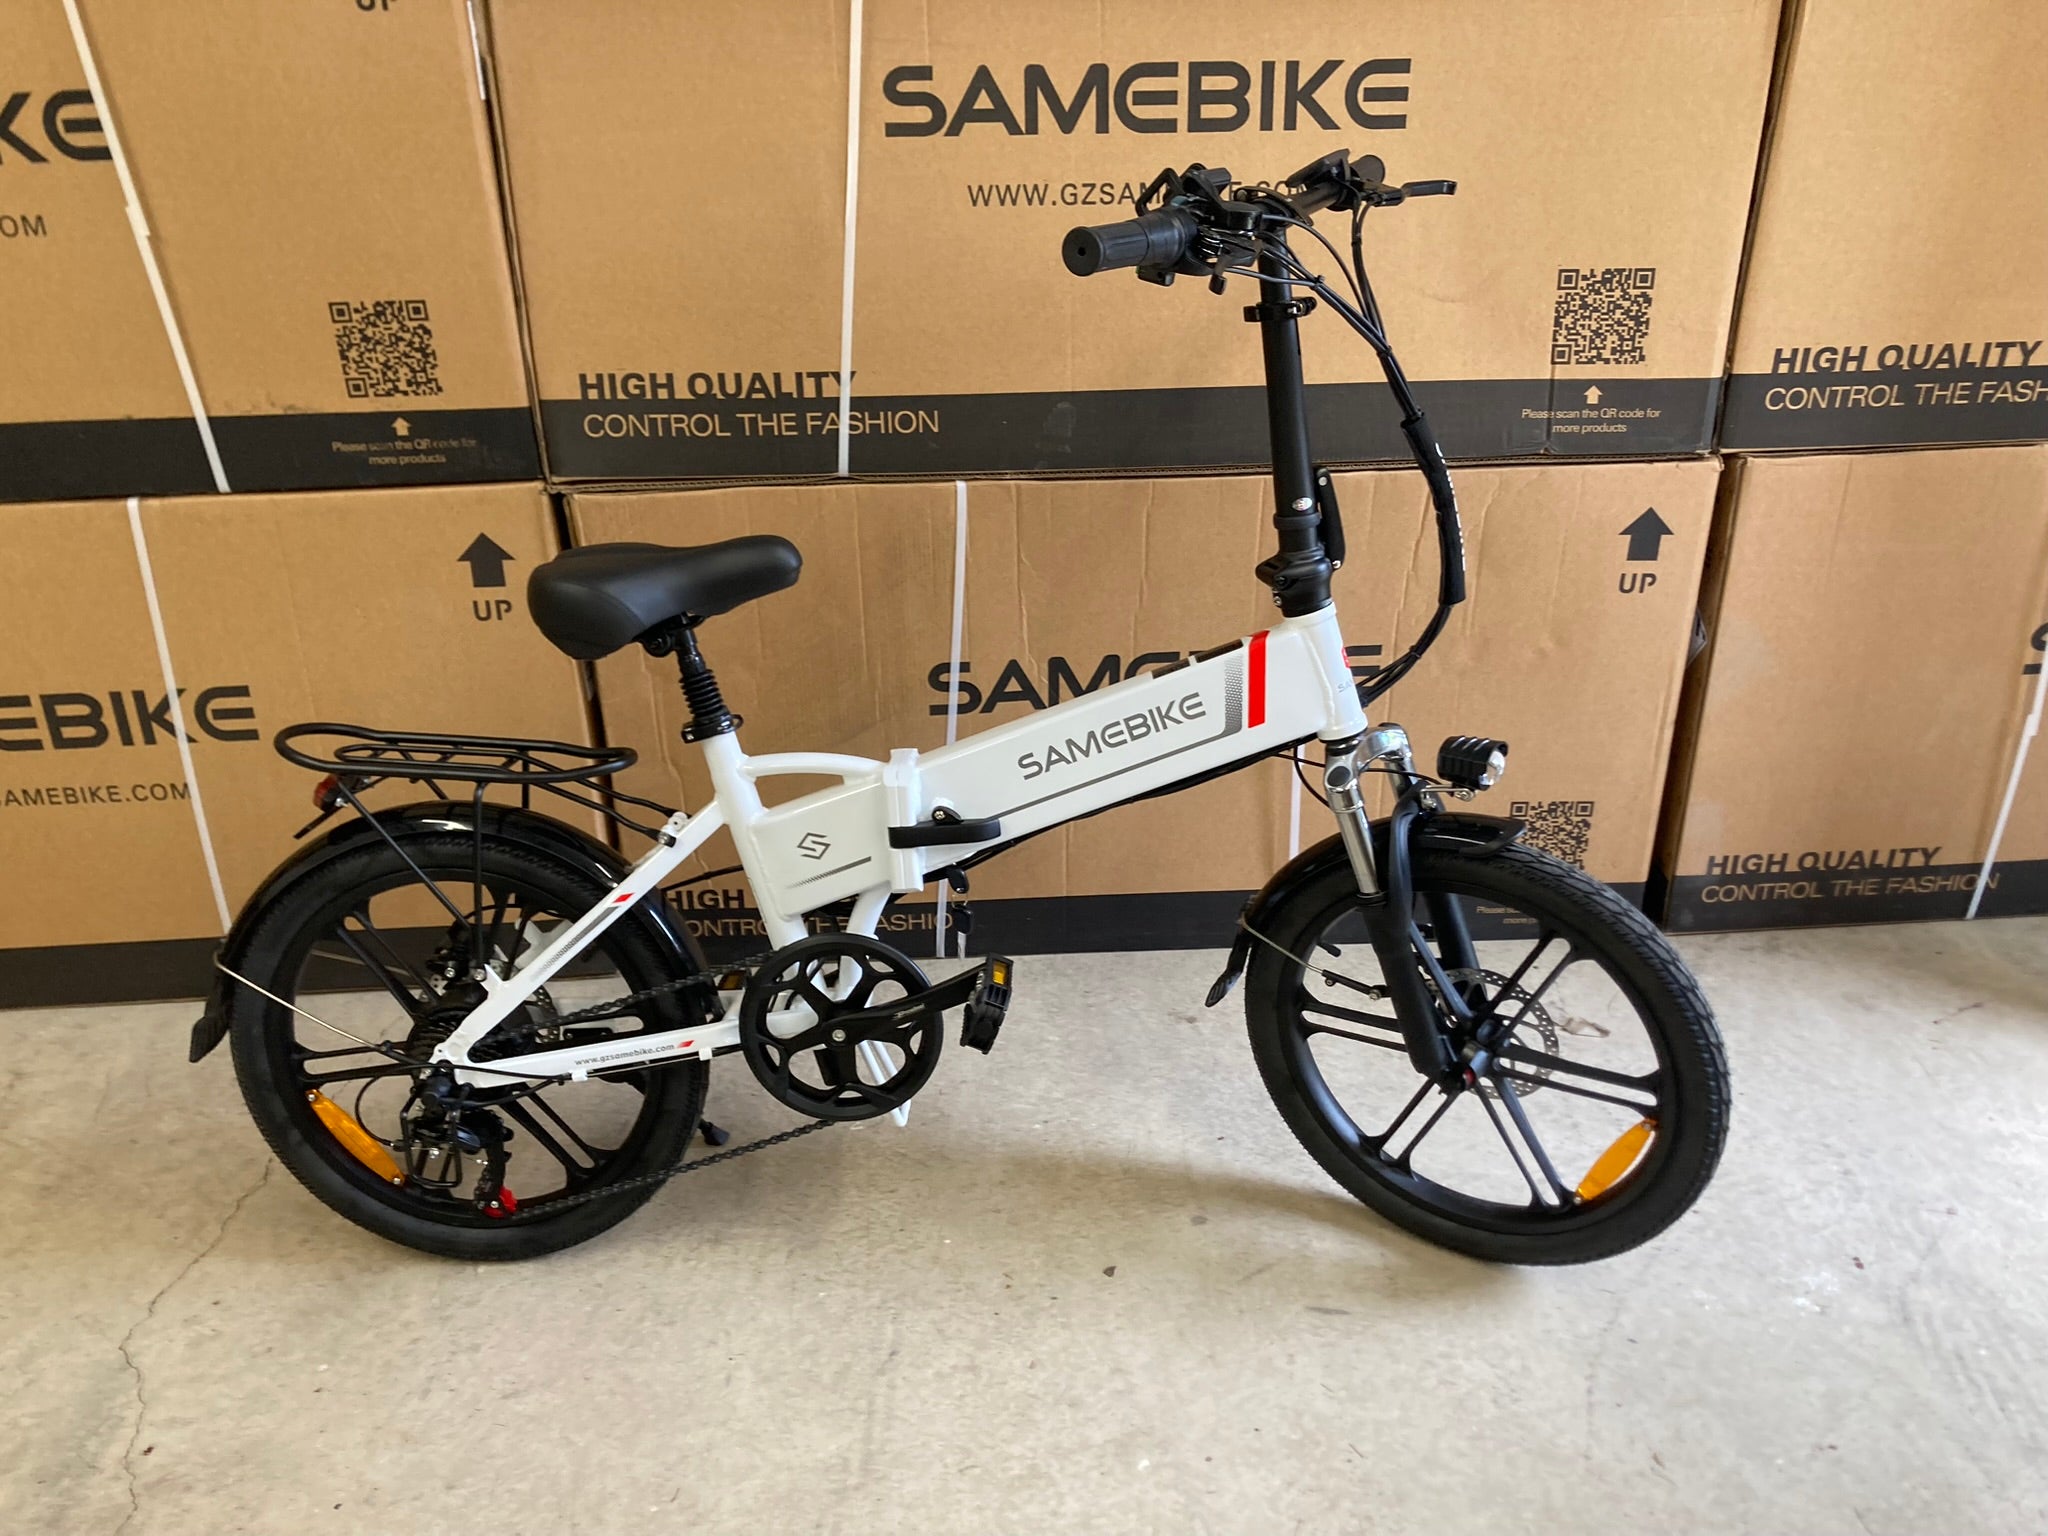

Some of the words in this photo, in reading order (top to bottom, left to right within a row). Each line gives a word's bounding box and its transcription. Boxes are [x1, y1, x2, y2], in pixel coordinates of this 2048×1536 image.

[883, 58, 1412, 138] SAMEBIKE
[1771, 346, 1869, 374] HIGH
[1877, 340, 2044, 372] QUALITY
[578, 372, 676, 400] HIGH
[687, 370, 858, 400] QUALITY
[1764, 384, 1906, 411] CONTROL
[1914, 382, 1974, 406] THE
[583, 413, 732, 438] CONTROL
[735, 412, 799, 437] THE
[806, 410, 941, 436] FASHION
[1521, 408, 1555, 419] Please
[1556, 409, 1580, 419] scan
[1582, 408, 1599, 418] the
[1600, 407, 1617, 419] QR
[1618, 407, 1645, 418] code
[1646, 407, 1662, 418] for
[1552, 425, 1580, 433] more
[1581, 423, 1628, 435] products
[331, 440, 367, 452] Please
[399, 453, 447, 466] products
[1619, 573, 1657, 594] UP
[472, 599, 513, 622] UP
[1017, 691, 1207, 781] SAMEBIKE
[1706, 852, 1789, 876] HIGH
[1797, 846, 1942, 872] QUALITY
[1701, 881, 1824, 904] CONTROL
[1831, 878, 1882, 898] THE
[1885, 872, 2001, 895] FASHION
[574, 1043, 675, 1067] www.gzsamebike.com
